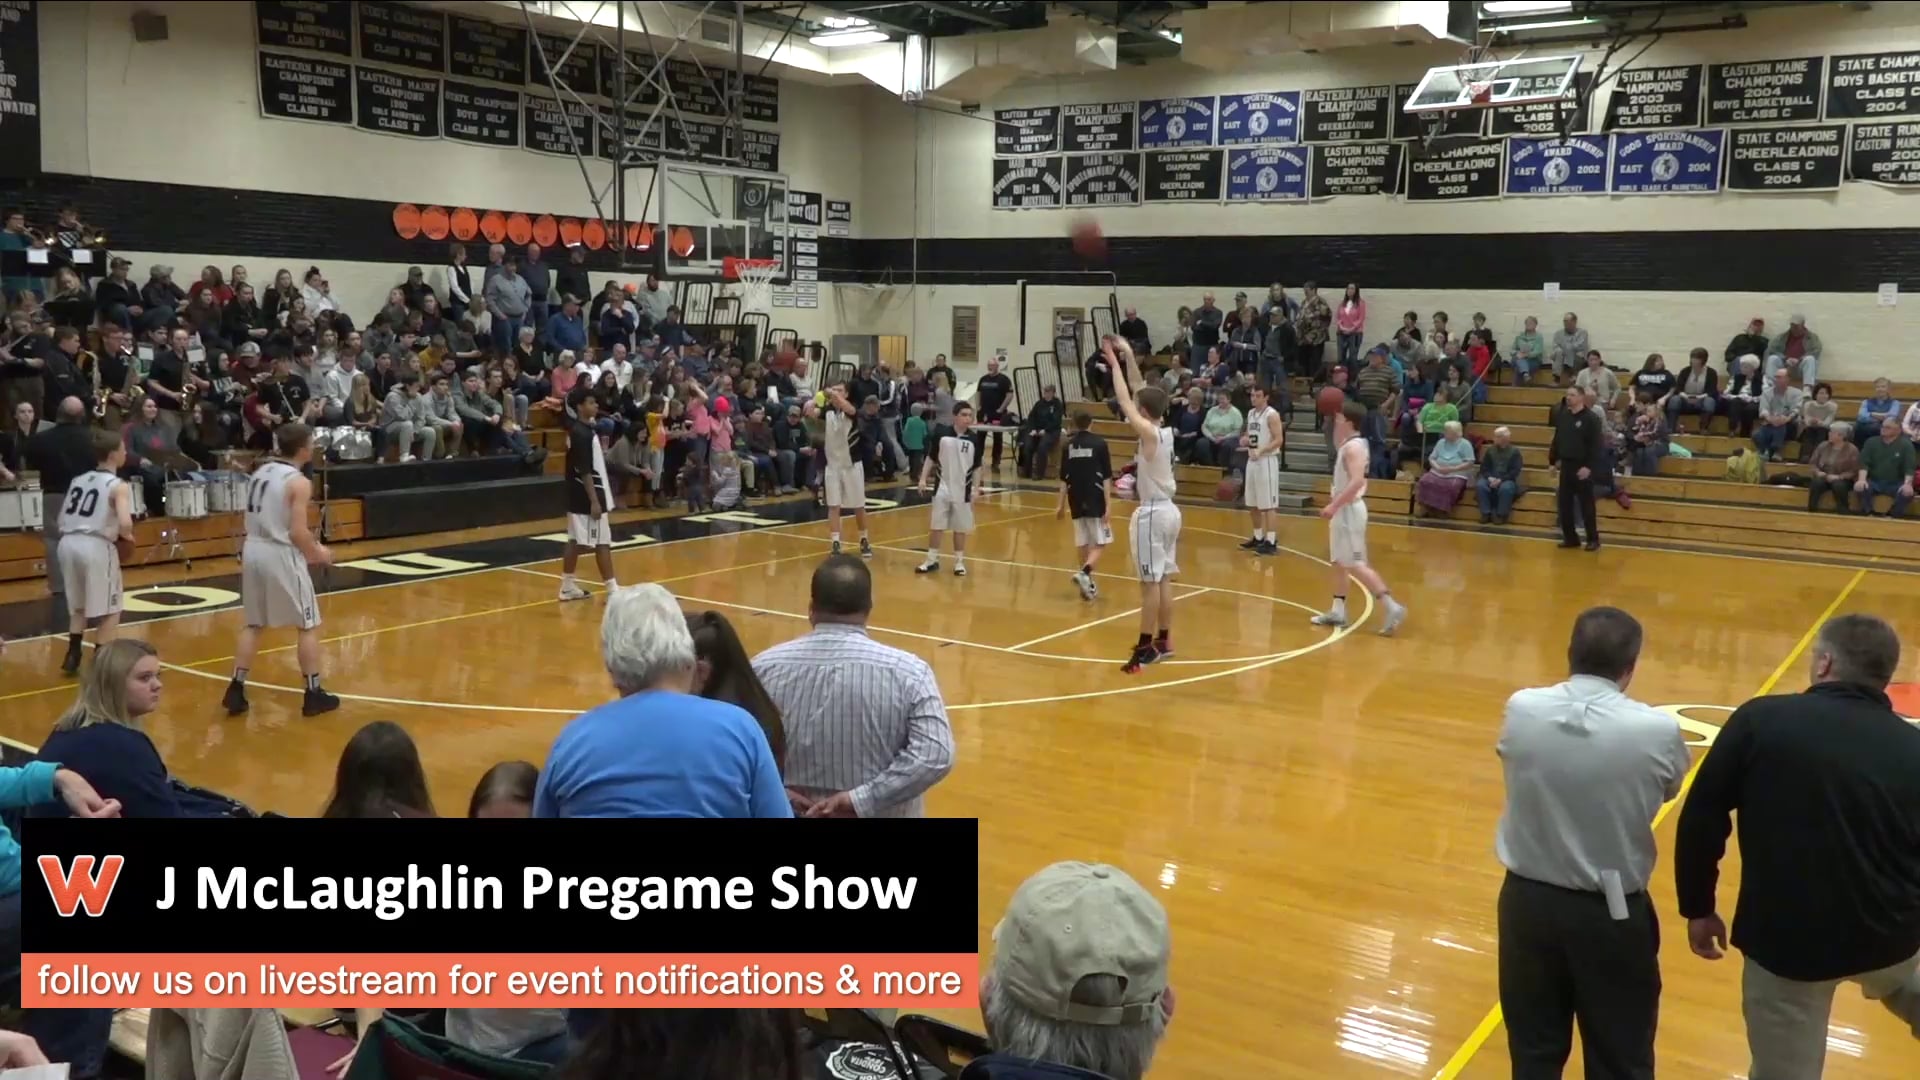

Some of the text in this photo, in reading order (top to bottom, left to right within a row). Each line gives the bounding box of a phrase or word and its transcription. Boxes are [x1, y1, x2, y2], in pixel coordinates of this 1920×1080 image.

[1722, 60, 1808, 78] EASTERN MAINE
[1838, 58, 1875, 72] STATE
[1657, 68, 1690, 81] MAINE
[1833, 74, 1864, 87] BOYS
[1725, 74, 1803, 89] CHAMPIONS
[1305, 87, 1389, 101] EASTERN MAINE
[1744, 87, 1782, 98] 2004
[1856, 87, 1905, 99] CLASS
[1629, 94, 1664, 105] 2003
[1713, 96, 1813, 110] BOYS BASKETBALL
[1064, 105, 1102, 116] EASTERN
[1318, 100, 1377, 113] CHAMPIONS
[1643, 103, 1682, 114] SOCCER
[1866, 101, 1907, 112] 2004
[1075, 114, 1122, 125] CHAMPIONS
[1514, 112, 1553, 123] CLASS
[1619, 114, 1672, 126] CLASS C
[1732, 108, 1791, 120] CLASS C
[1224, 121, 1241, 129] EAST
[1738, 130, 1838, 145] STATE CHAMPIONS
[1857, 126, 1893, 138] STATE
[1324, 145, 1390, 157] EASTERN MAINE
[1619, 133, 1717, 157] GOOD SPORTSMANSHIP
[1653, 141, 1684, 151] AWARD
[1855, 139, 1892, 151] EASTERN
[1190, 153, 1210, 161] MAINE
[1513, 145, 1533, 163] GOOD
[1544, 147, 1572, 158] AWARD
[1734, 145, 1839, 160] CHEERLEADING
[1326, 156, 1385, 167] CHAMPIONS
[1413, 158, 1496, 173] CHEERLEADING
[1754, 161, 1815, 172] CLASS C
[1342, 167, 1368, 176] 2001
[1514, 165, 1600, 176] EAST 2002
[1620, 163, 1711, 173] EAST 2004
[1232, 175, 1250, 184] EAST
[1428, 174, 1466, 184] CLASS
[1764, 175, 1802, 185] 2004
[1438, 185, 1468, 195] 2002
[65, 487, 99, 517] 30
[248, 480, 269, 513] 11
